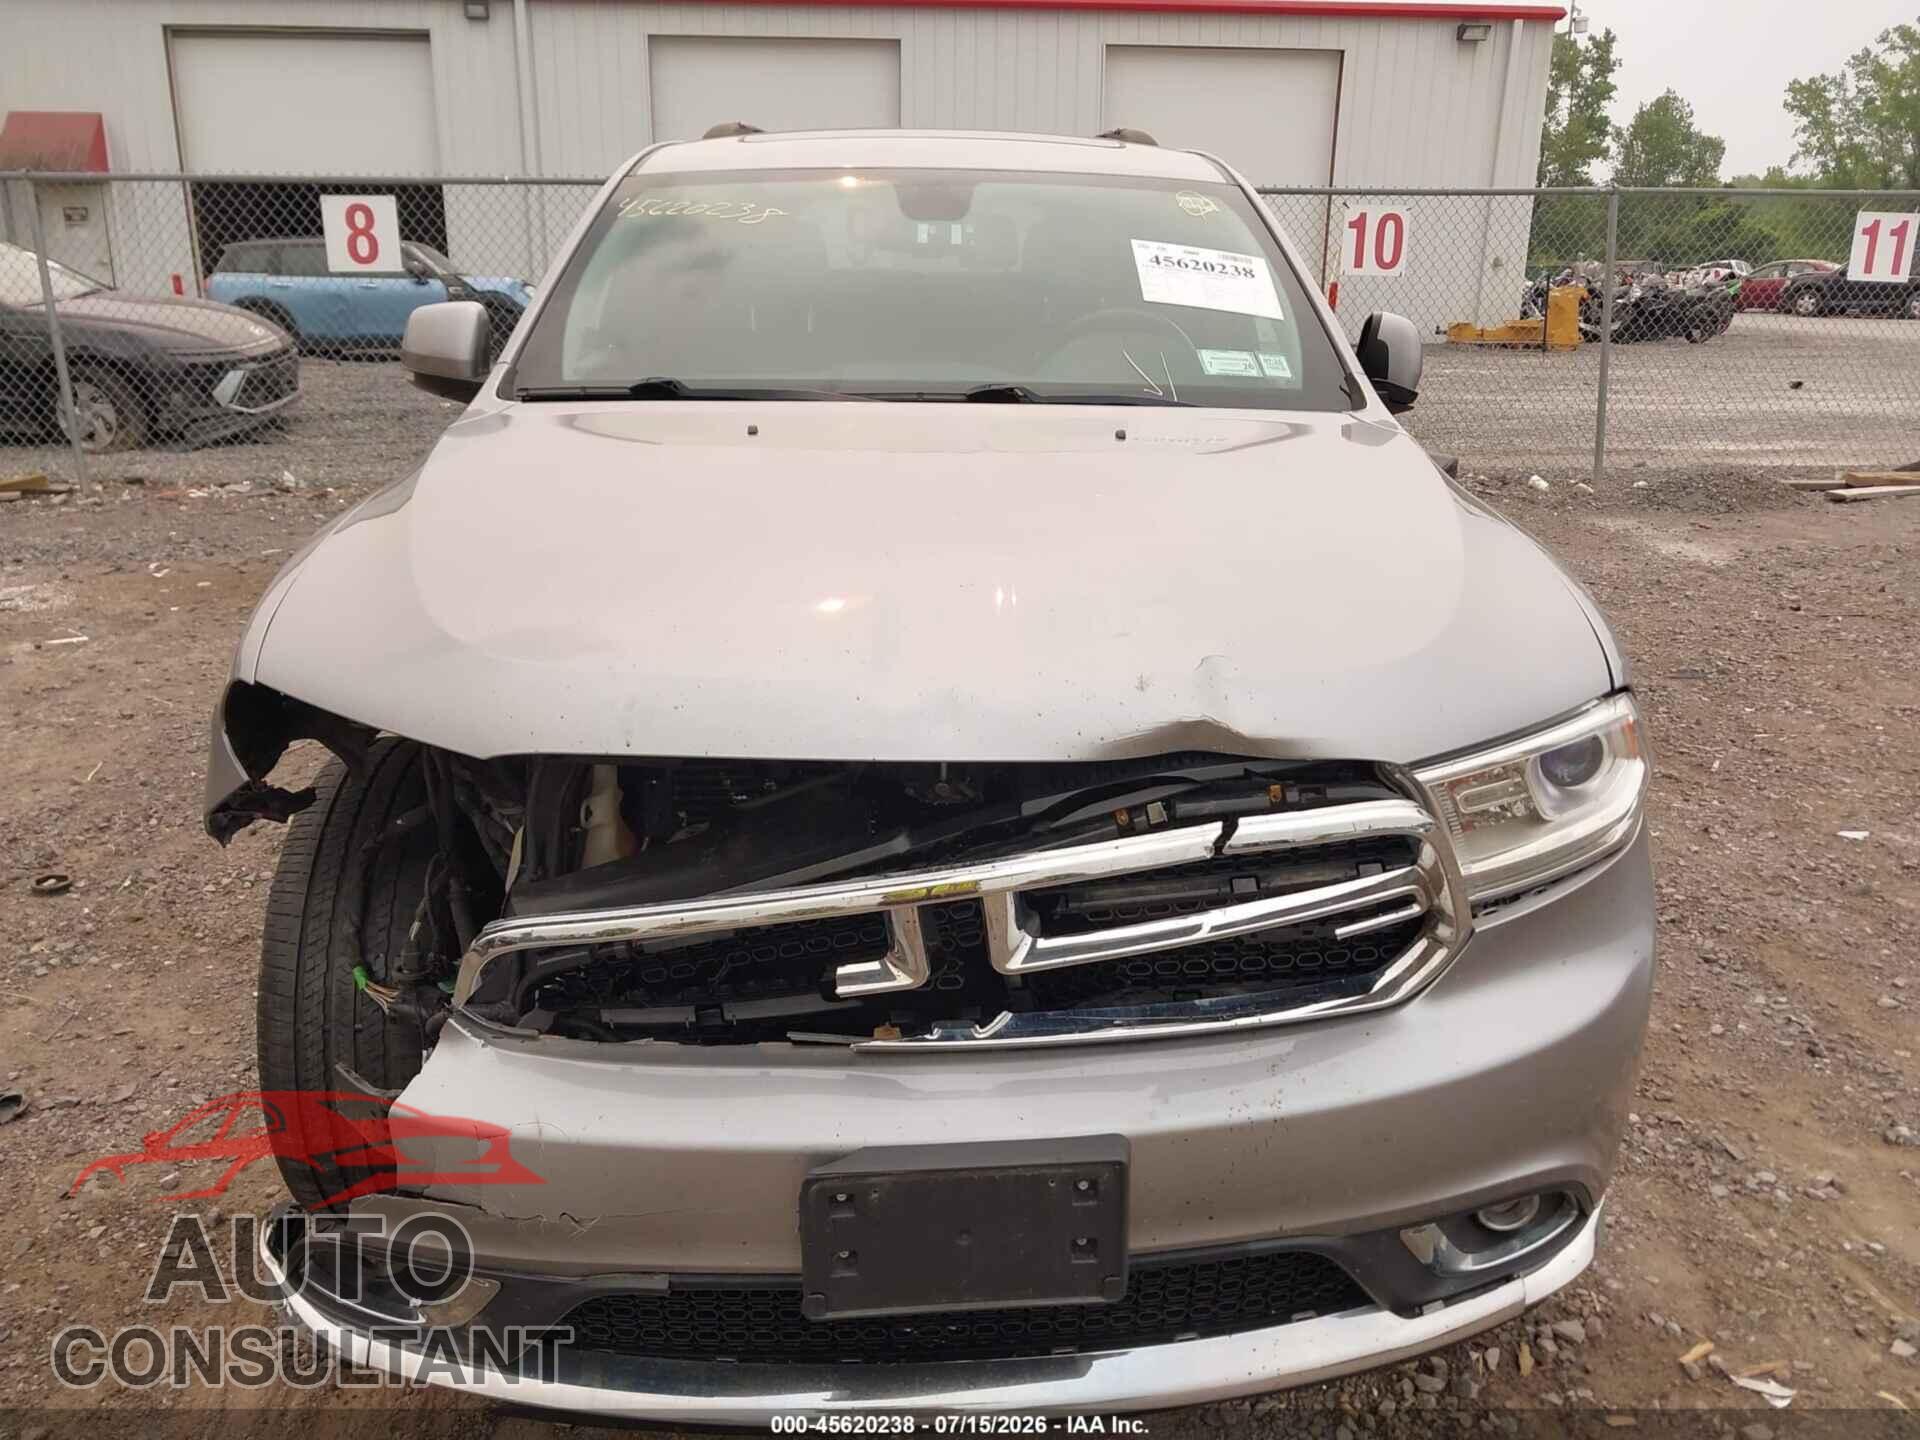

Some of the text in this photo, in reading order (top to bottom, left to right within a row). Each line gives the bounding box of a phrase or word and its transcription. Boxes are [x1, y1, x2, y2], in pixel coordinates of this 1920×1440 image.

[345, 203, 379, 265] 8
[1348, 212, 1404, 270] 10
[1862, 219, 1909, 275] 11
[1149, 253, 1256, 279] 45620238
